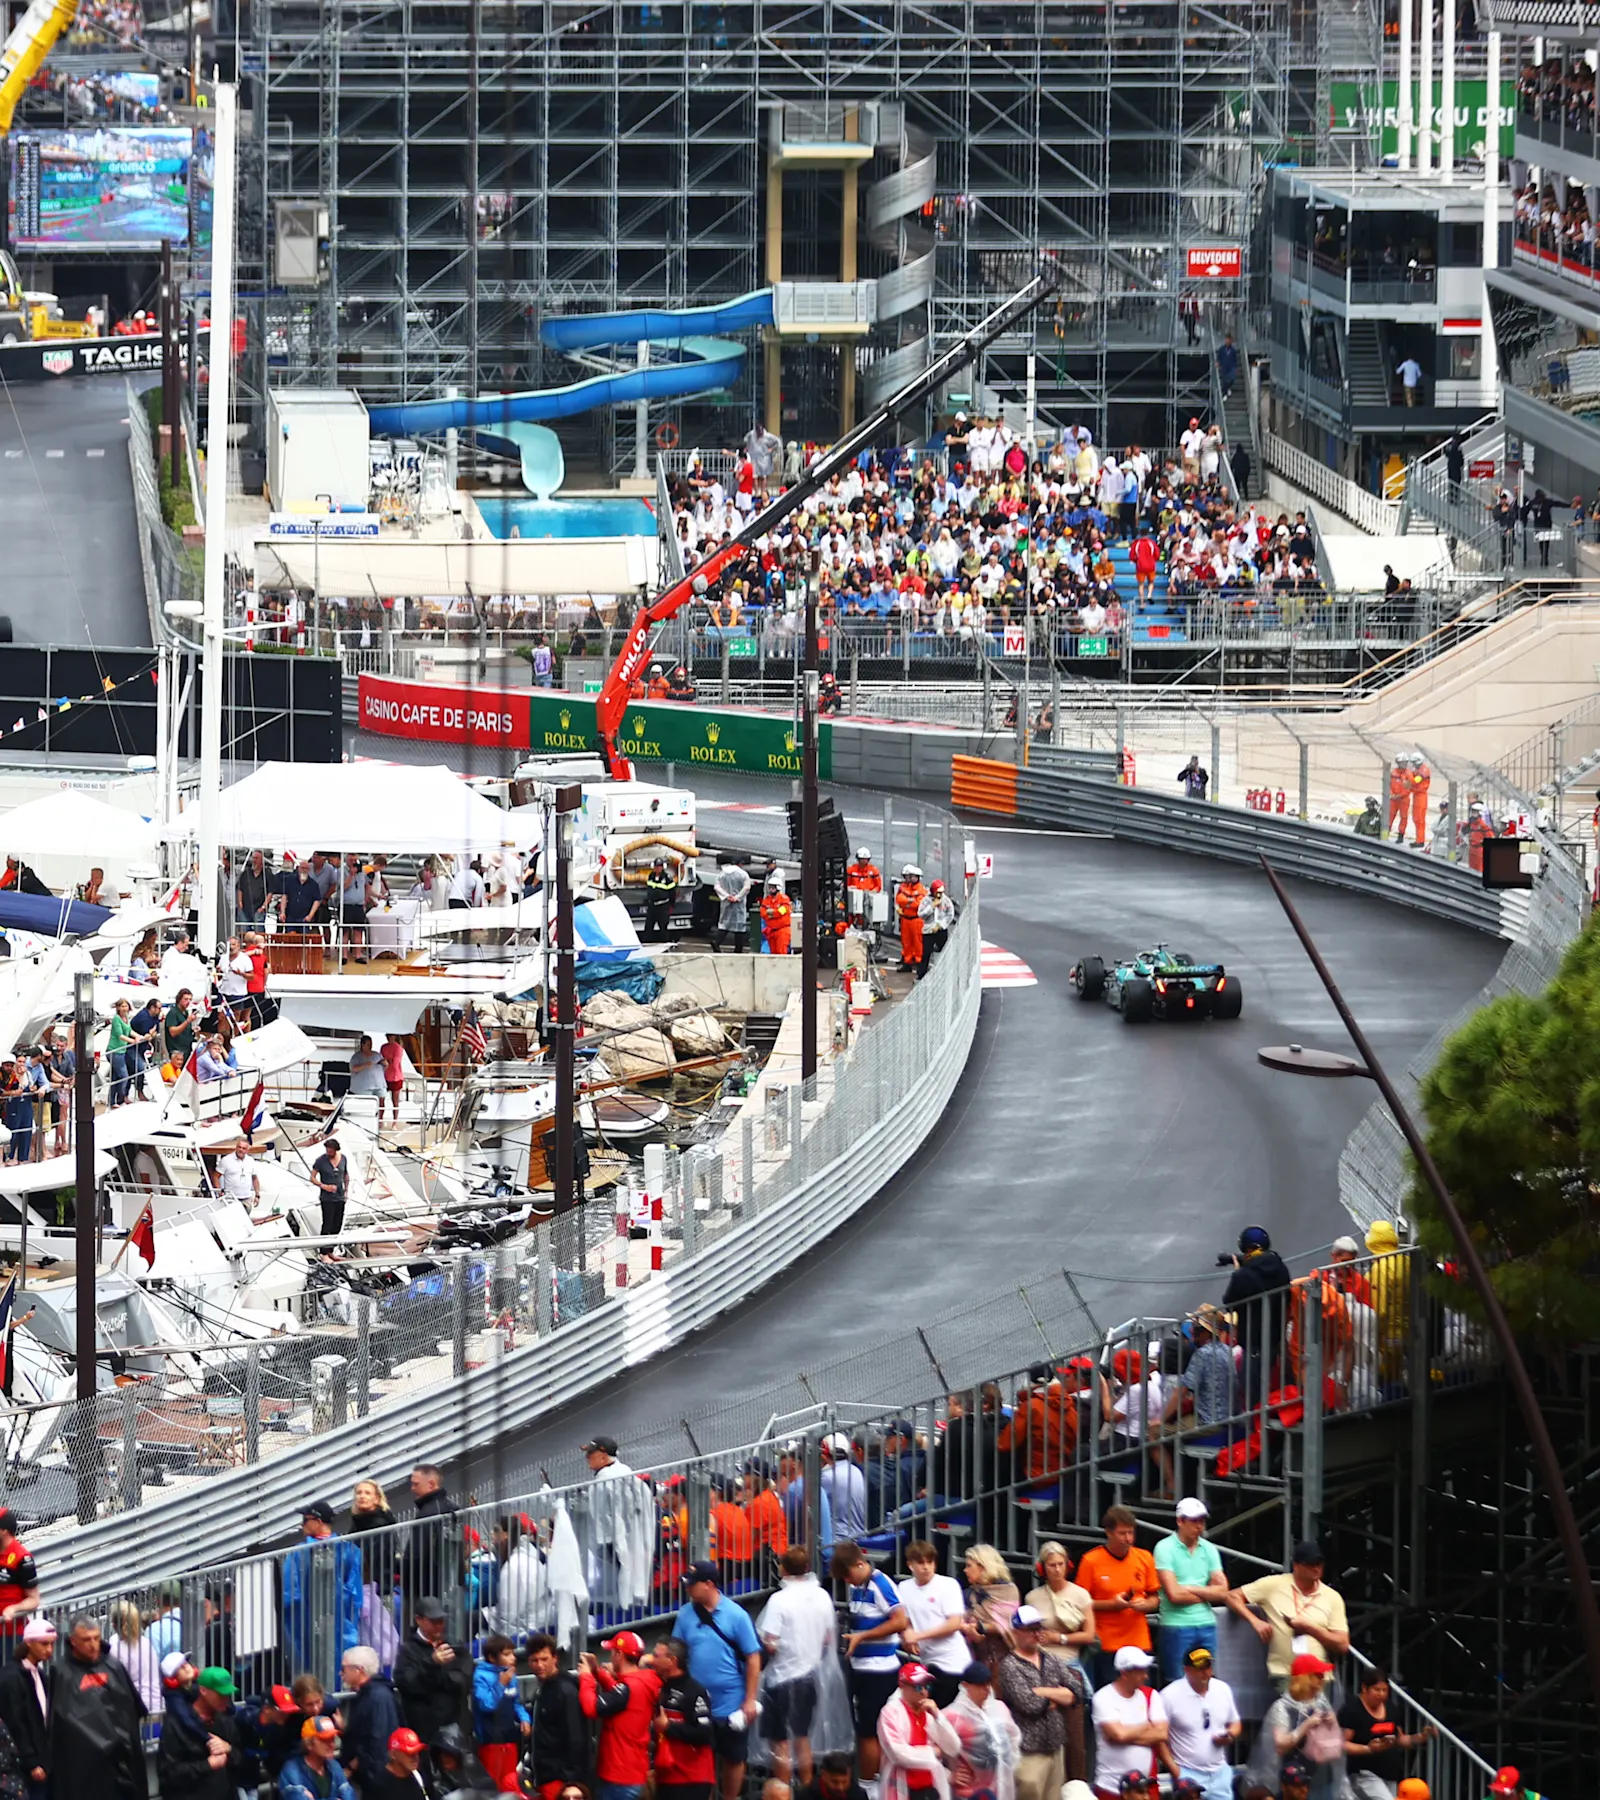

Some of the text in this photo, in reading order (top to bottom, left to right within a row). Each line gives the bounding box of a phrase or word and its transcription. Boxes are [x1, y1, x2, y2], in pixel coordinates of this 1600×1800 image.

[1190, 251, 1238, 264] BELVEDERE
[1006, 637, 1025, 651] M
[365, 695, 513, 733] CASINO CAFE DE PARIS
[544, 731, 586, 749] ROLEX
[690, 745, 736, 764] ROLEX
[1162, 965, 1215, 973] aramco
[162, 1148, 184, 1159] 96041
